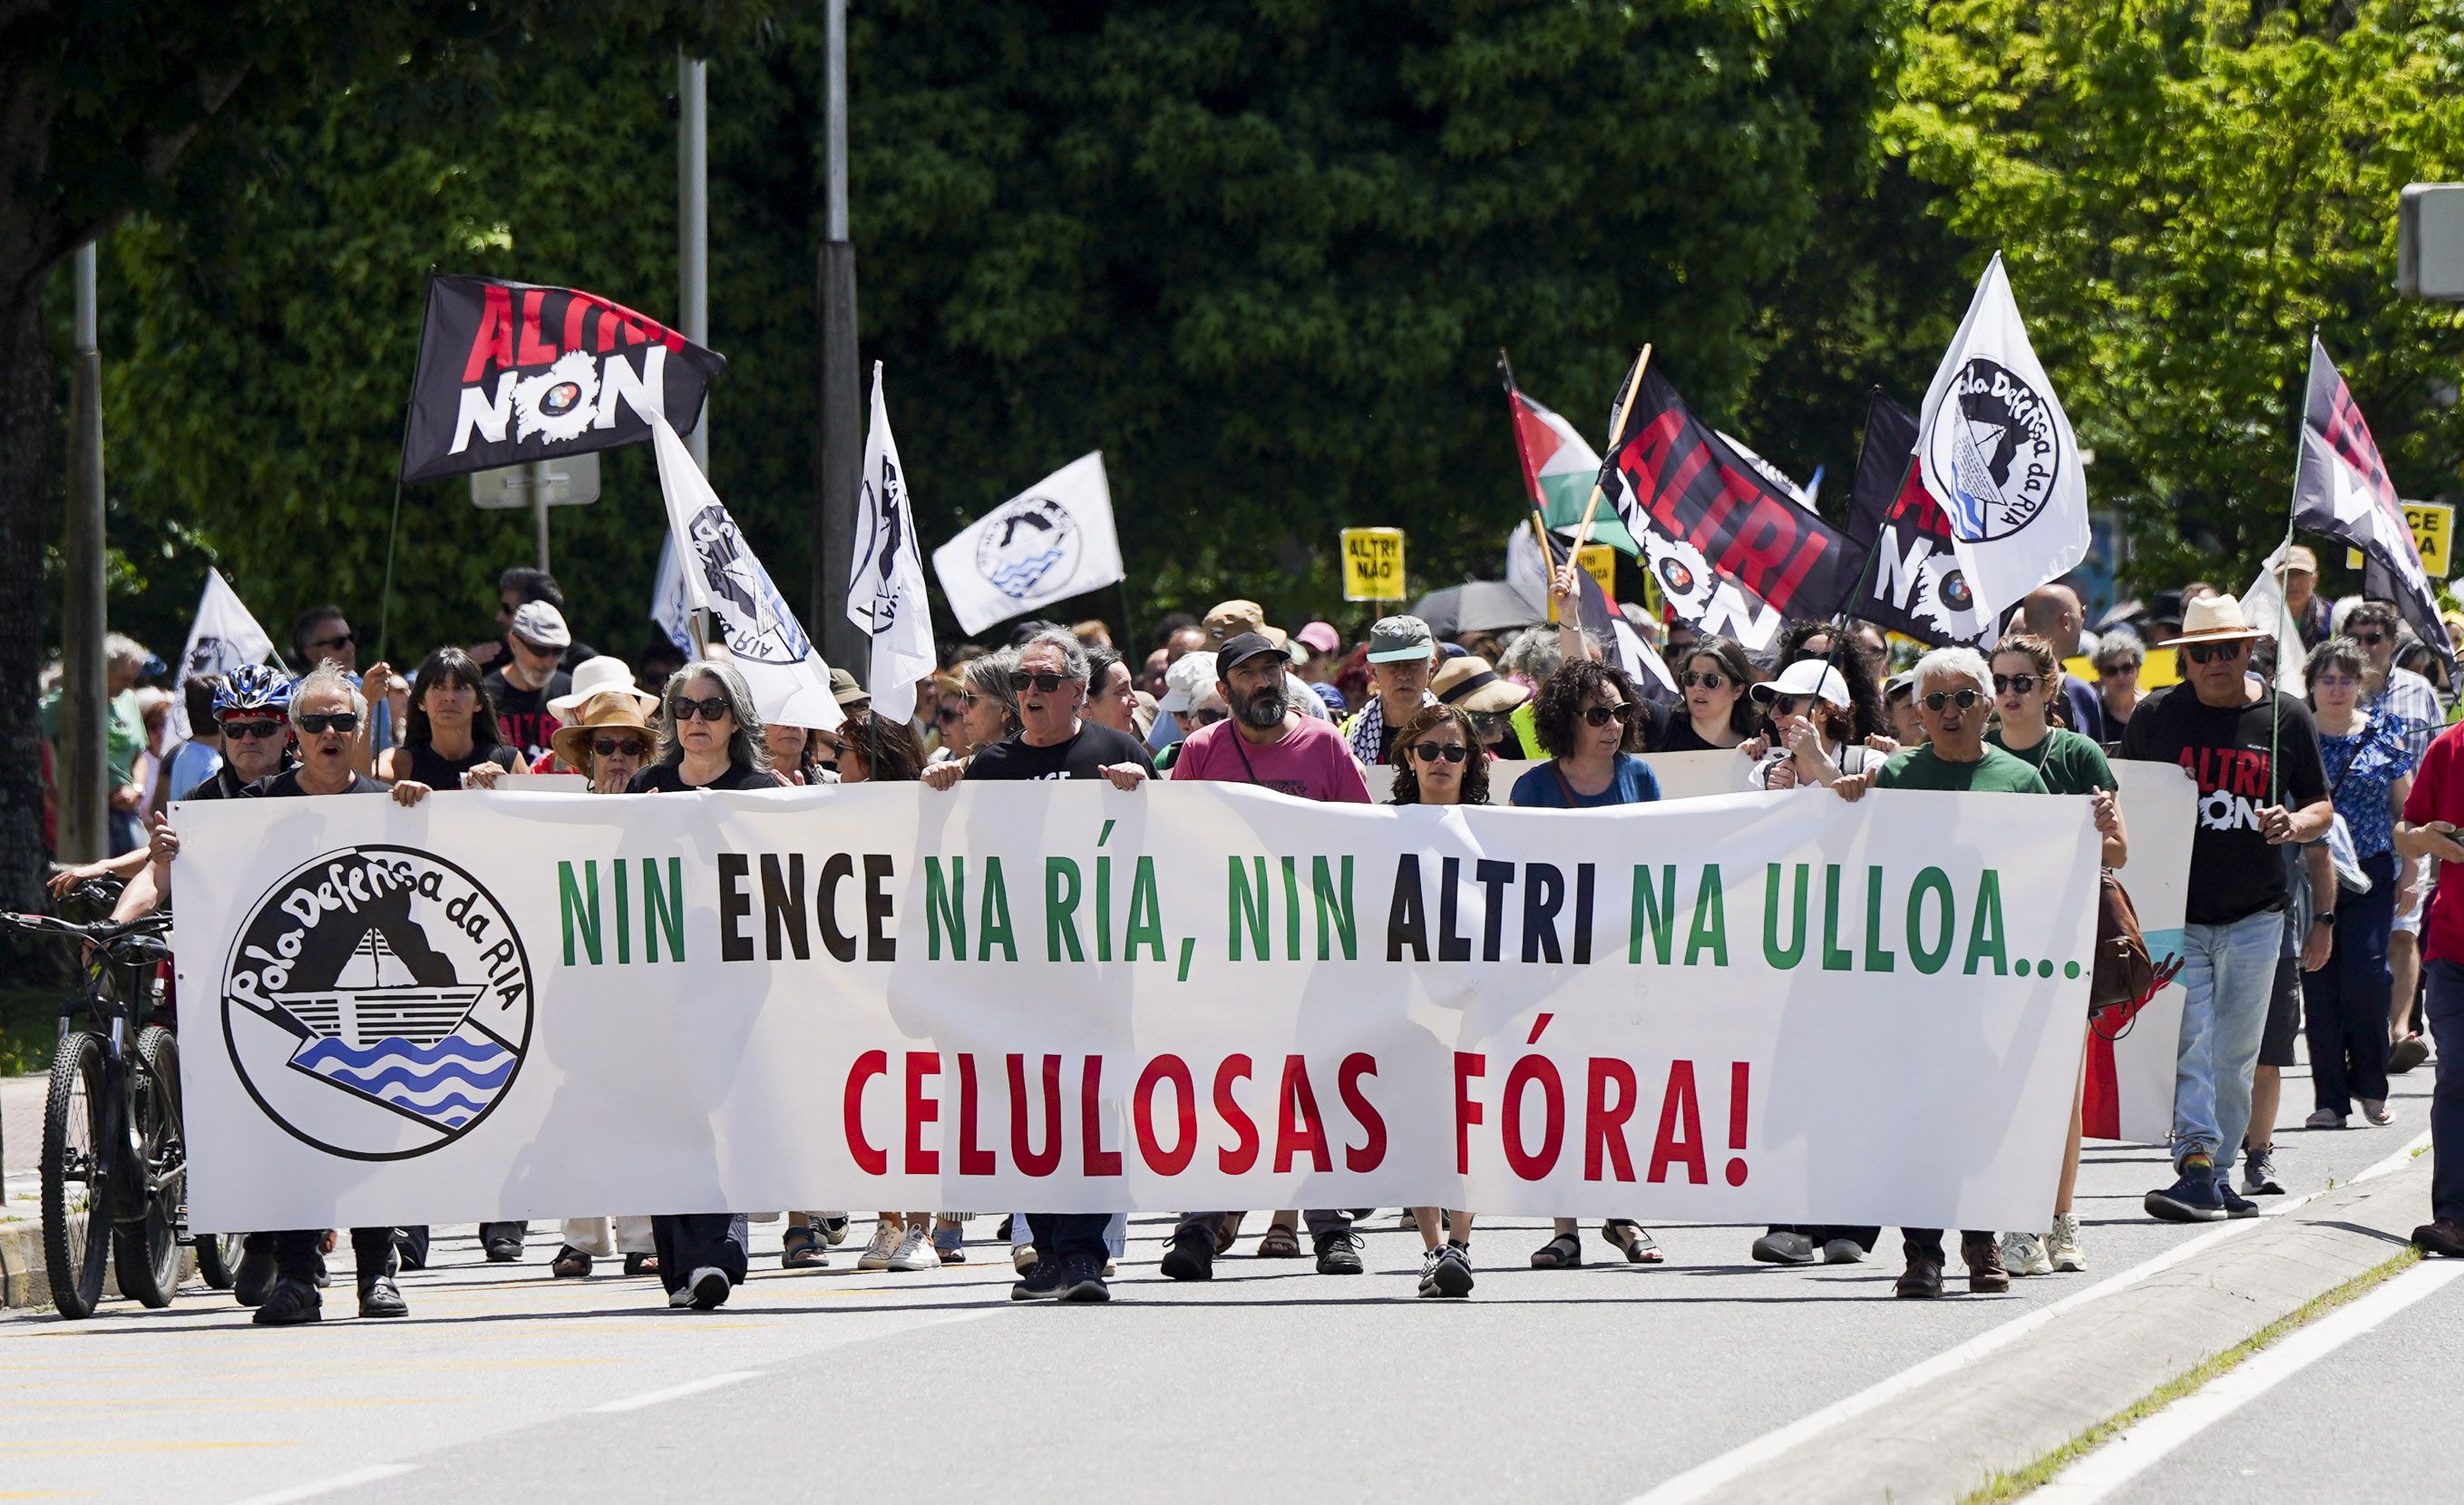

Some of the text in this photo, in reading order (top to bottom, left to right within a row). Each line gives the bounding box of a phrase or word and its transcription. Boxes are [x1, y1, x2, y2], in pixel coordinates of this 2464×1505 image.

[448, 345, 667, 455] NON
[1959, 364, 2051, 526] ola Defensa da RIA
[1349, 537, 1398, 558] ALTRI
[1615, 466, 1782, 651] NON
[1618, 406, 1830, 613] ALTRI
[2405, 511, 2440, 533] CE
[497, 712, 563, 748] ALTR
[2177, 746, 2271, 797] ALTRI
[2198, 789, 2264, 832] ON
[231, 858, 525, 1011] Pola Defensa da RIA
[558, 819, 2080, 982] NIN ENCE NA RÍA, NIN ALTRI NA ULLOA...
[843, 1012, 1749, 1187] CELULOSAS FÓRA!
